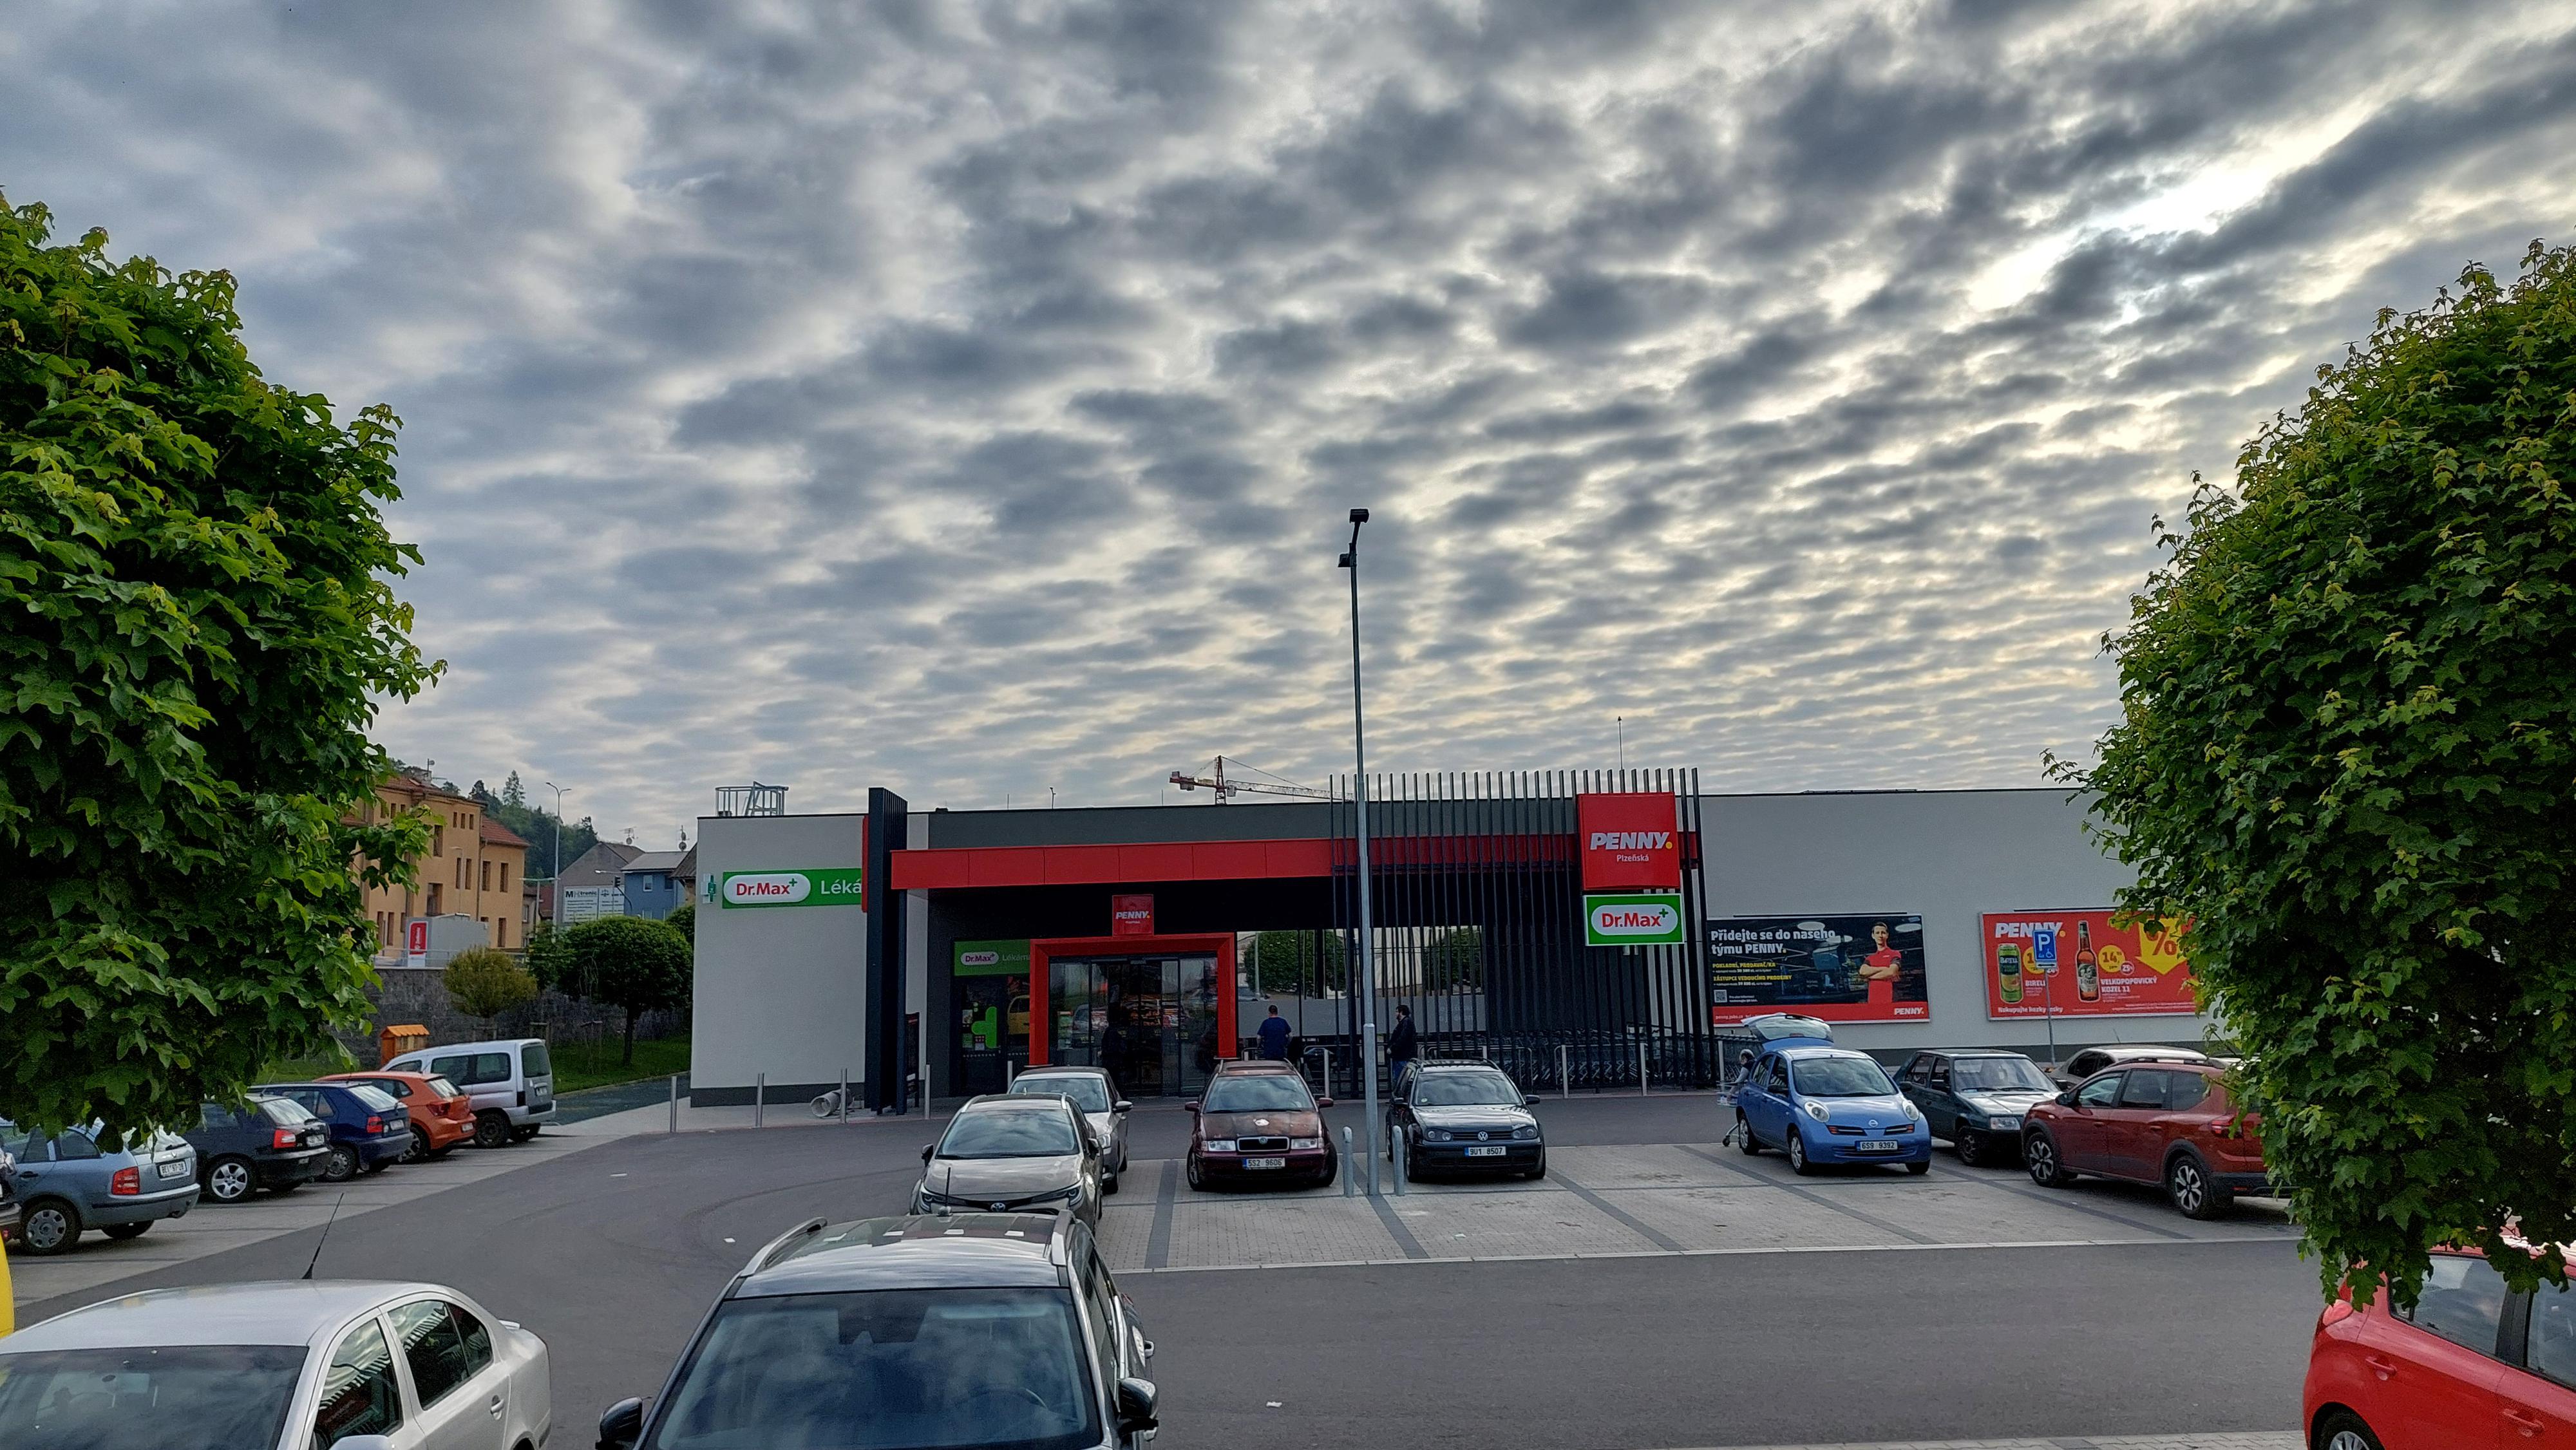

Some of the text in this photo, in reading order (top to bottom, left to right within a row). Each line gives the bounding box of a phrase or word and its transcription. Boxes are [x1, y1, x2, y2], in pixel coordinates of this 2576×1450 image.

[1590, 832, 1672, 850] PENNY.
[1115, 910, 1150, 919] PENNY.
[1710, 928, 1758, 943] Přidejte
[1759, 932, 1773, 940] se
[1775, 929, 1791, 940] do
[2038, 934, 2050, 951] P
[1711, 943, 1786, 956] týmu PENNY.
